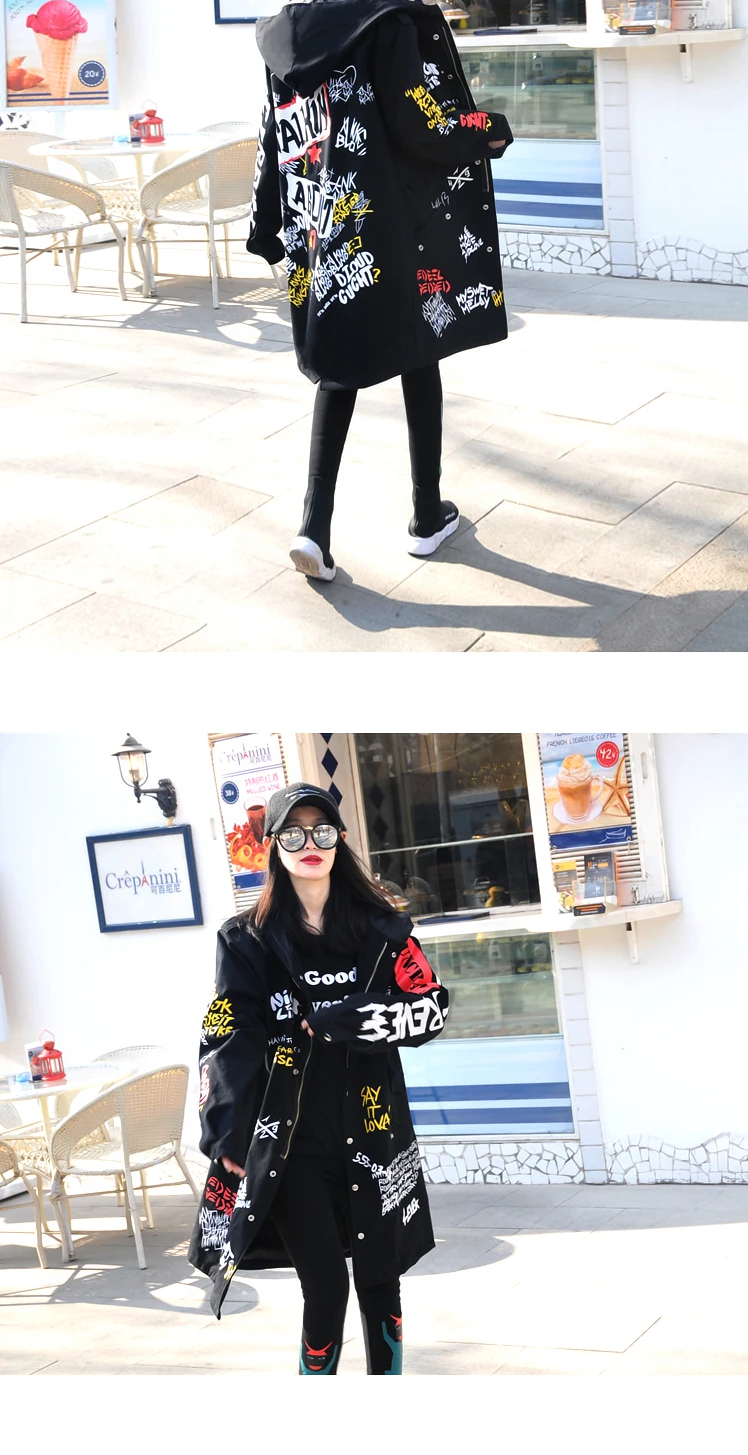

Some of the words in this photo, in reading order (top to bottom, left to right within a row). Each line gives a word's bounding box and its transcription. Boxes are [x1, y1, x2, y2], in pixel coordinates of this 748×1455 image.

[546, 739, 568, 748] FRENCH
[569, 735, 594, 745] LIEGEOIS
[596, 732, 617, 741] COFFEE
[360, 1086, 381, 1107] SAY
[367, 1105, 381, 1119] IT
